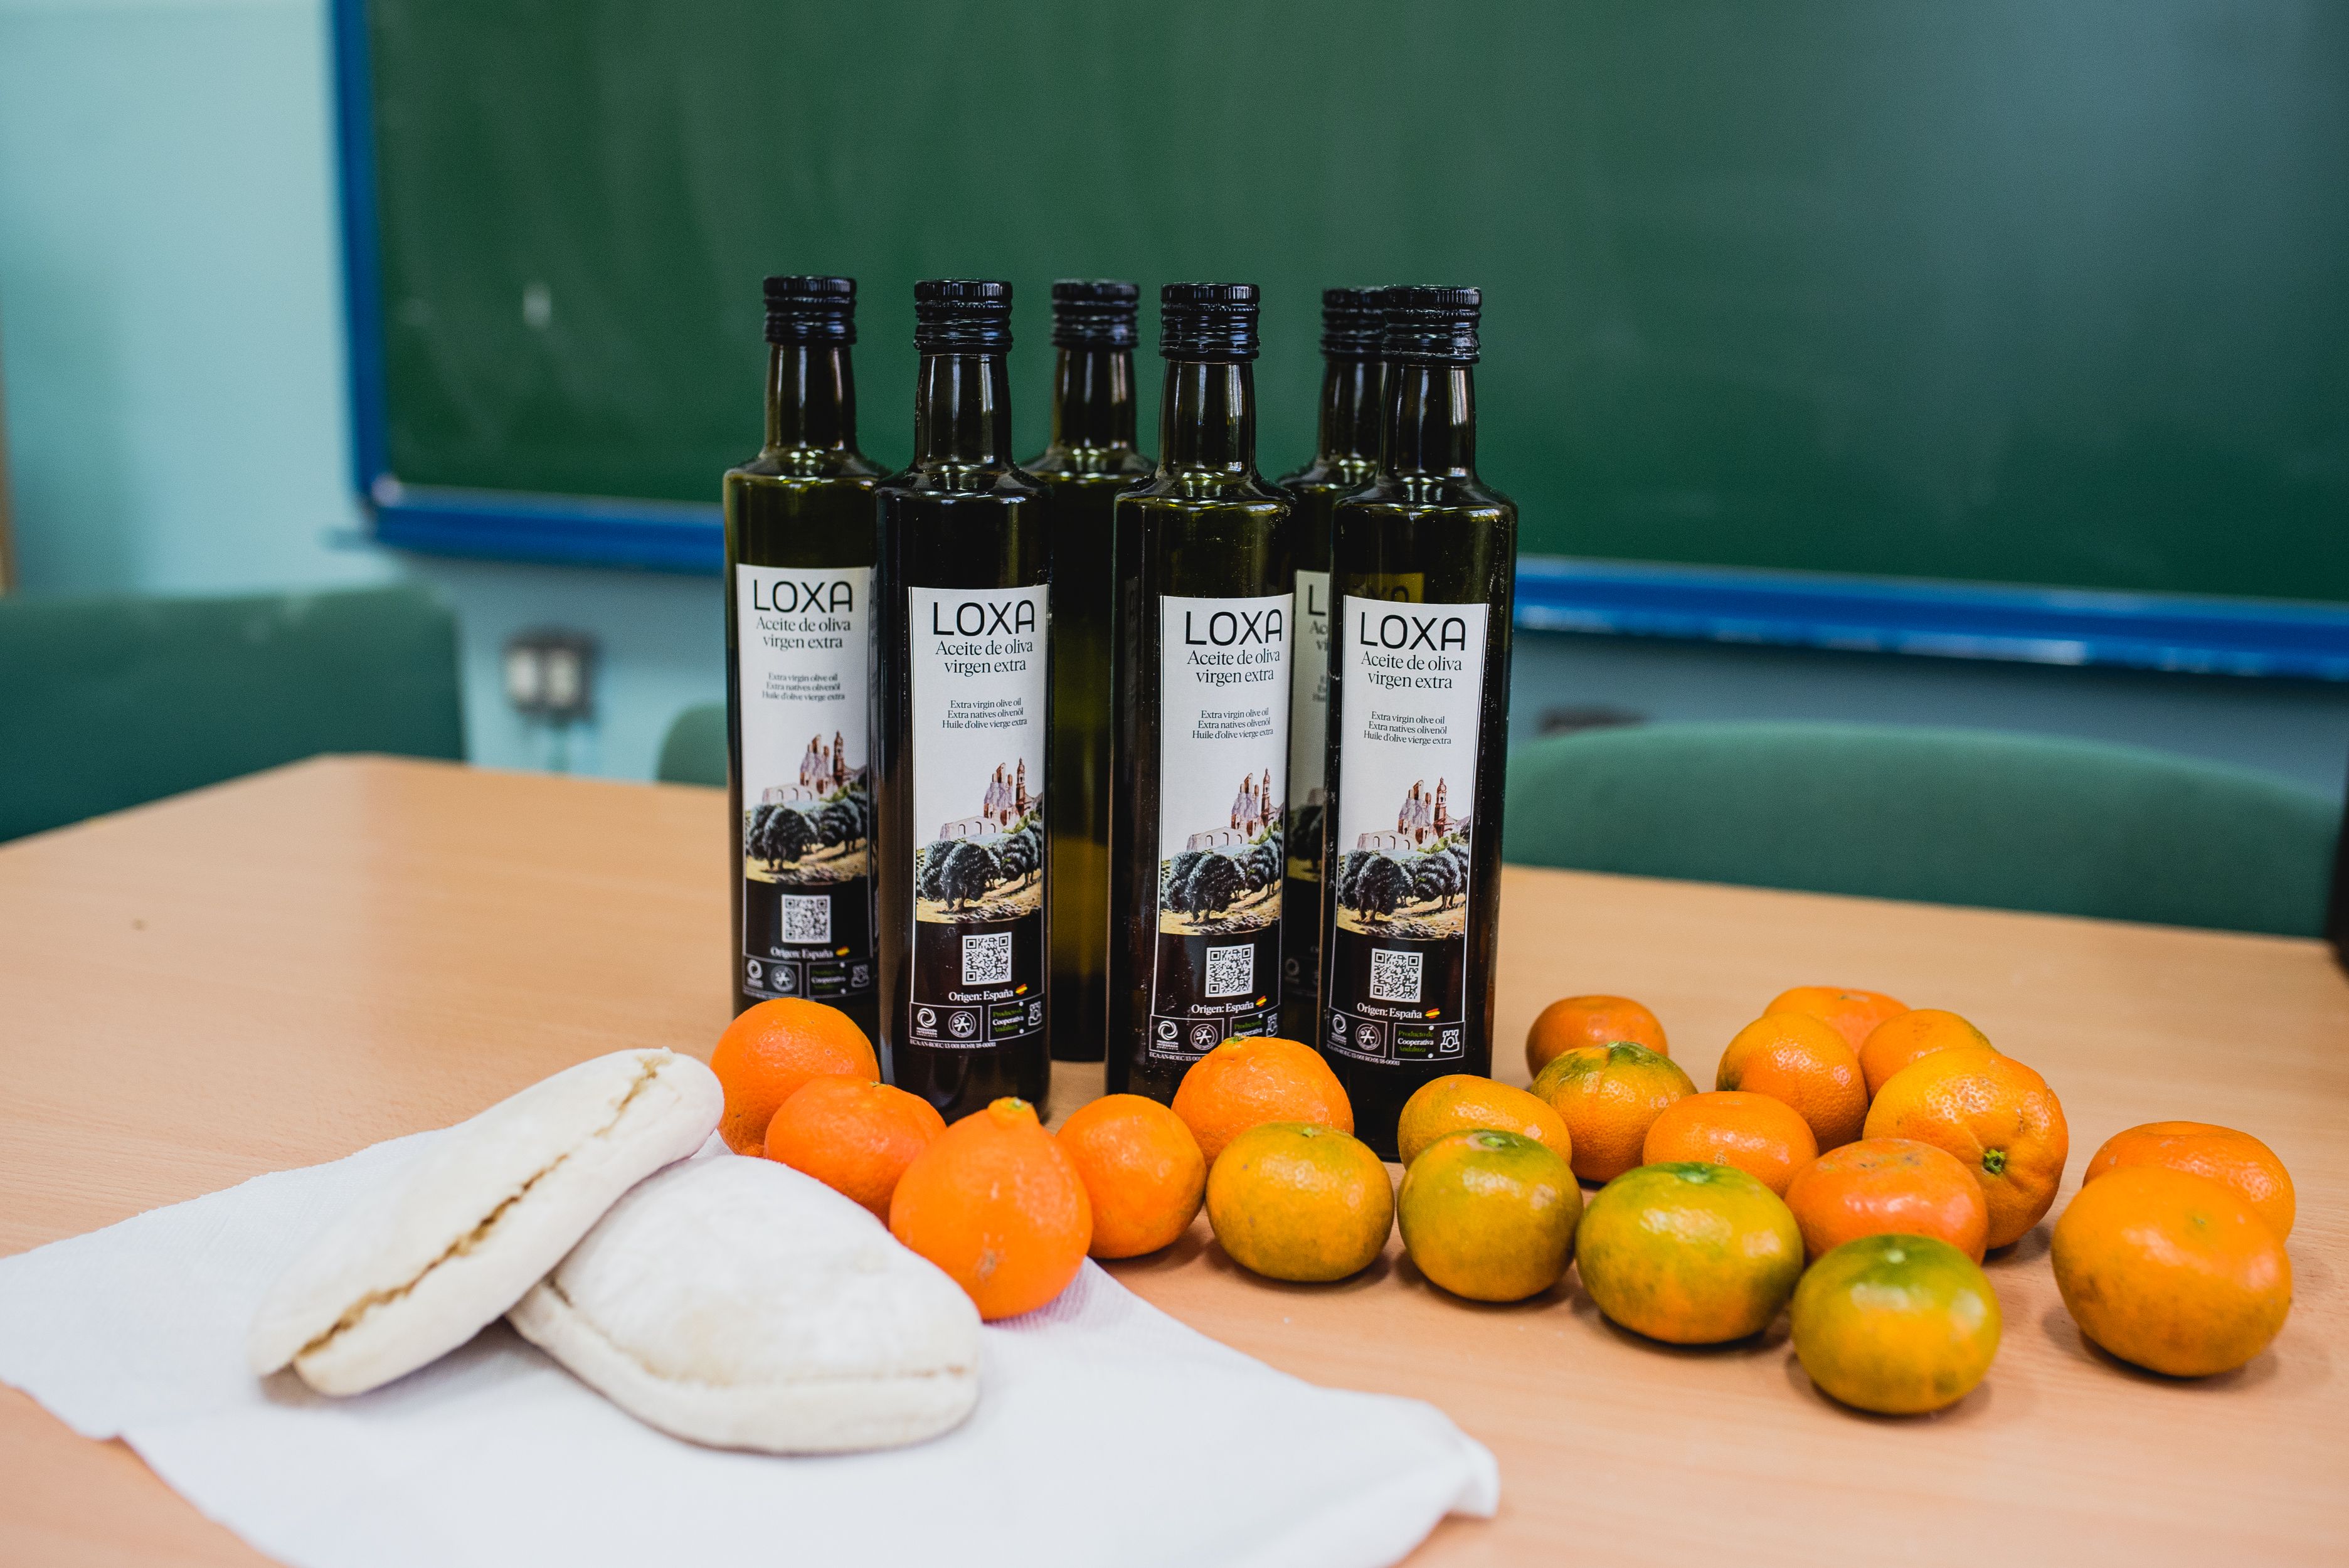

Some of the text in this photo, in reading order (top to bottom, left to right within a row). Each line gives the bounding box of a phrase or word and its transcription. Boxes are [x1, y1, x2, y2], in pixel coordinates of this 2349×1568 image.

[755, 580, 852, 613] LOXA
[756, 617, 851, 632] Aceite de oliva
[933, 600, 1034, 636] LOXA
[1185, 609, 1282, 646] LOXA
[1360, 612, 1466, 650] LOXA
[763, 634, 842, 651] virgen extra
[935, 639, 1033, 655] Aceite de oliva
[1187, 649, 1280, 665] Aceite de oliva
[1361, 651, 1461, 670] Aceite de oliva
[945, 660, 1026, 677] virgen extra
[1196, 669, 1273, 687] virgen extra
[1368, 671, 1452, 689] virgen extra
[973, 701, 994, 709] virgin
[996, 699, 1012, 707] olive
[970, 710, 996, 718] natives
[998, 707, 1023, 717] olivenöl
[1223, 711, 1244, 719] virgin
[1246, 709, 1260, 718] olive
[1372, 711, 1391, 721] Extra
[1392, 715, 1414, 724] virgin
[1416, 716, 1433, 724] olive
[990, 721, 1010, 729] vierge
[1247, 718, 1270, 727] olivenöl
[1369, 721, 1387, 731] Extra
[1389, 724, 1415, 733] natives
[1239, 731, 1258, 739] vierge
[1364, 731, 1382, 740] Huile
[1384, 734, 1406, 743] d'olive
[1408, 736, 1431, 745] vierge
[948, 989, 1014, 1003] Origen: España
[1191, 1002, 1254, 1015] Origen: España
[1357, 1002, 1422, 1020] Origen: España
[992, 1015, 1024, 1025] Cooperativa
[1397, 1038, 1434, 1047] Cooperativa
